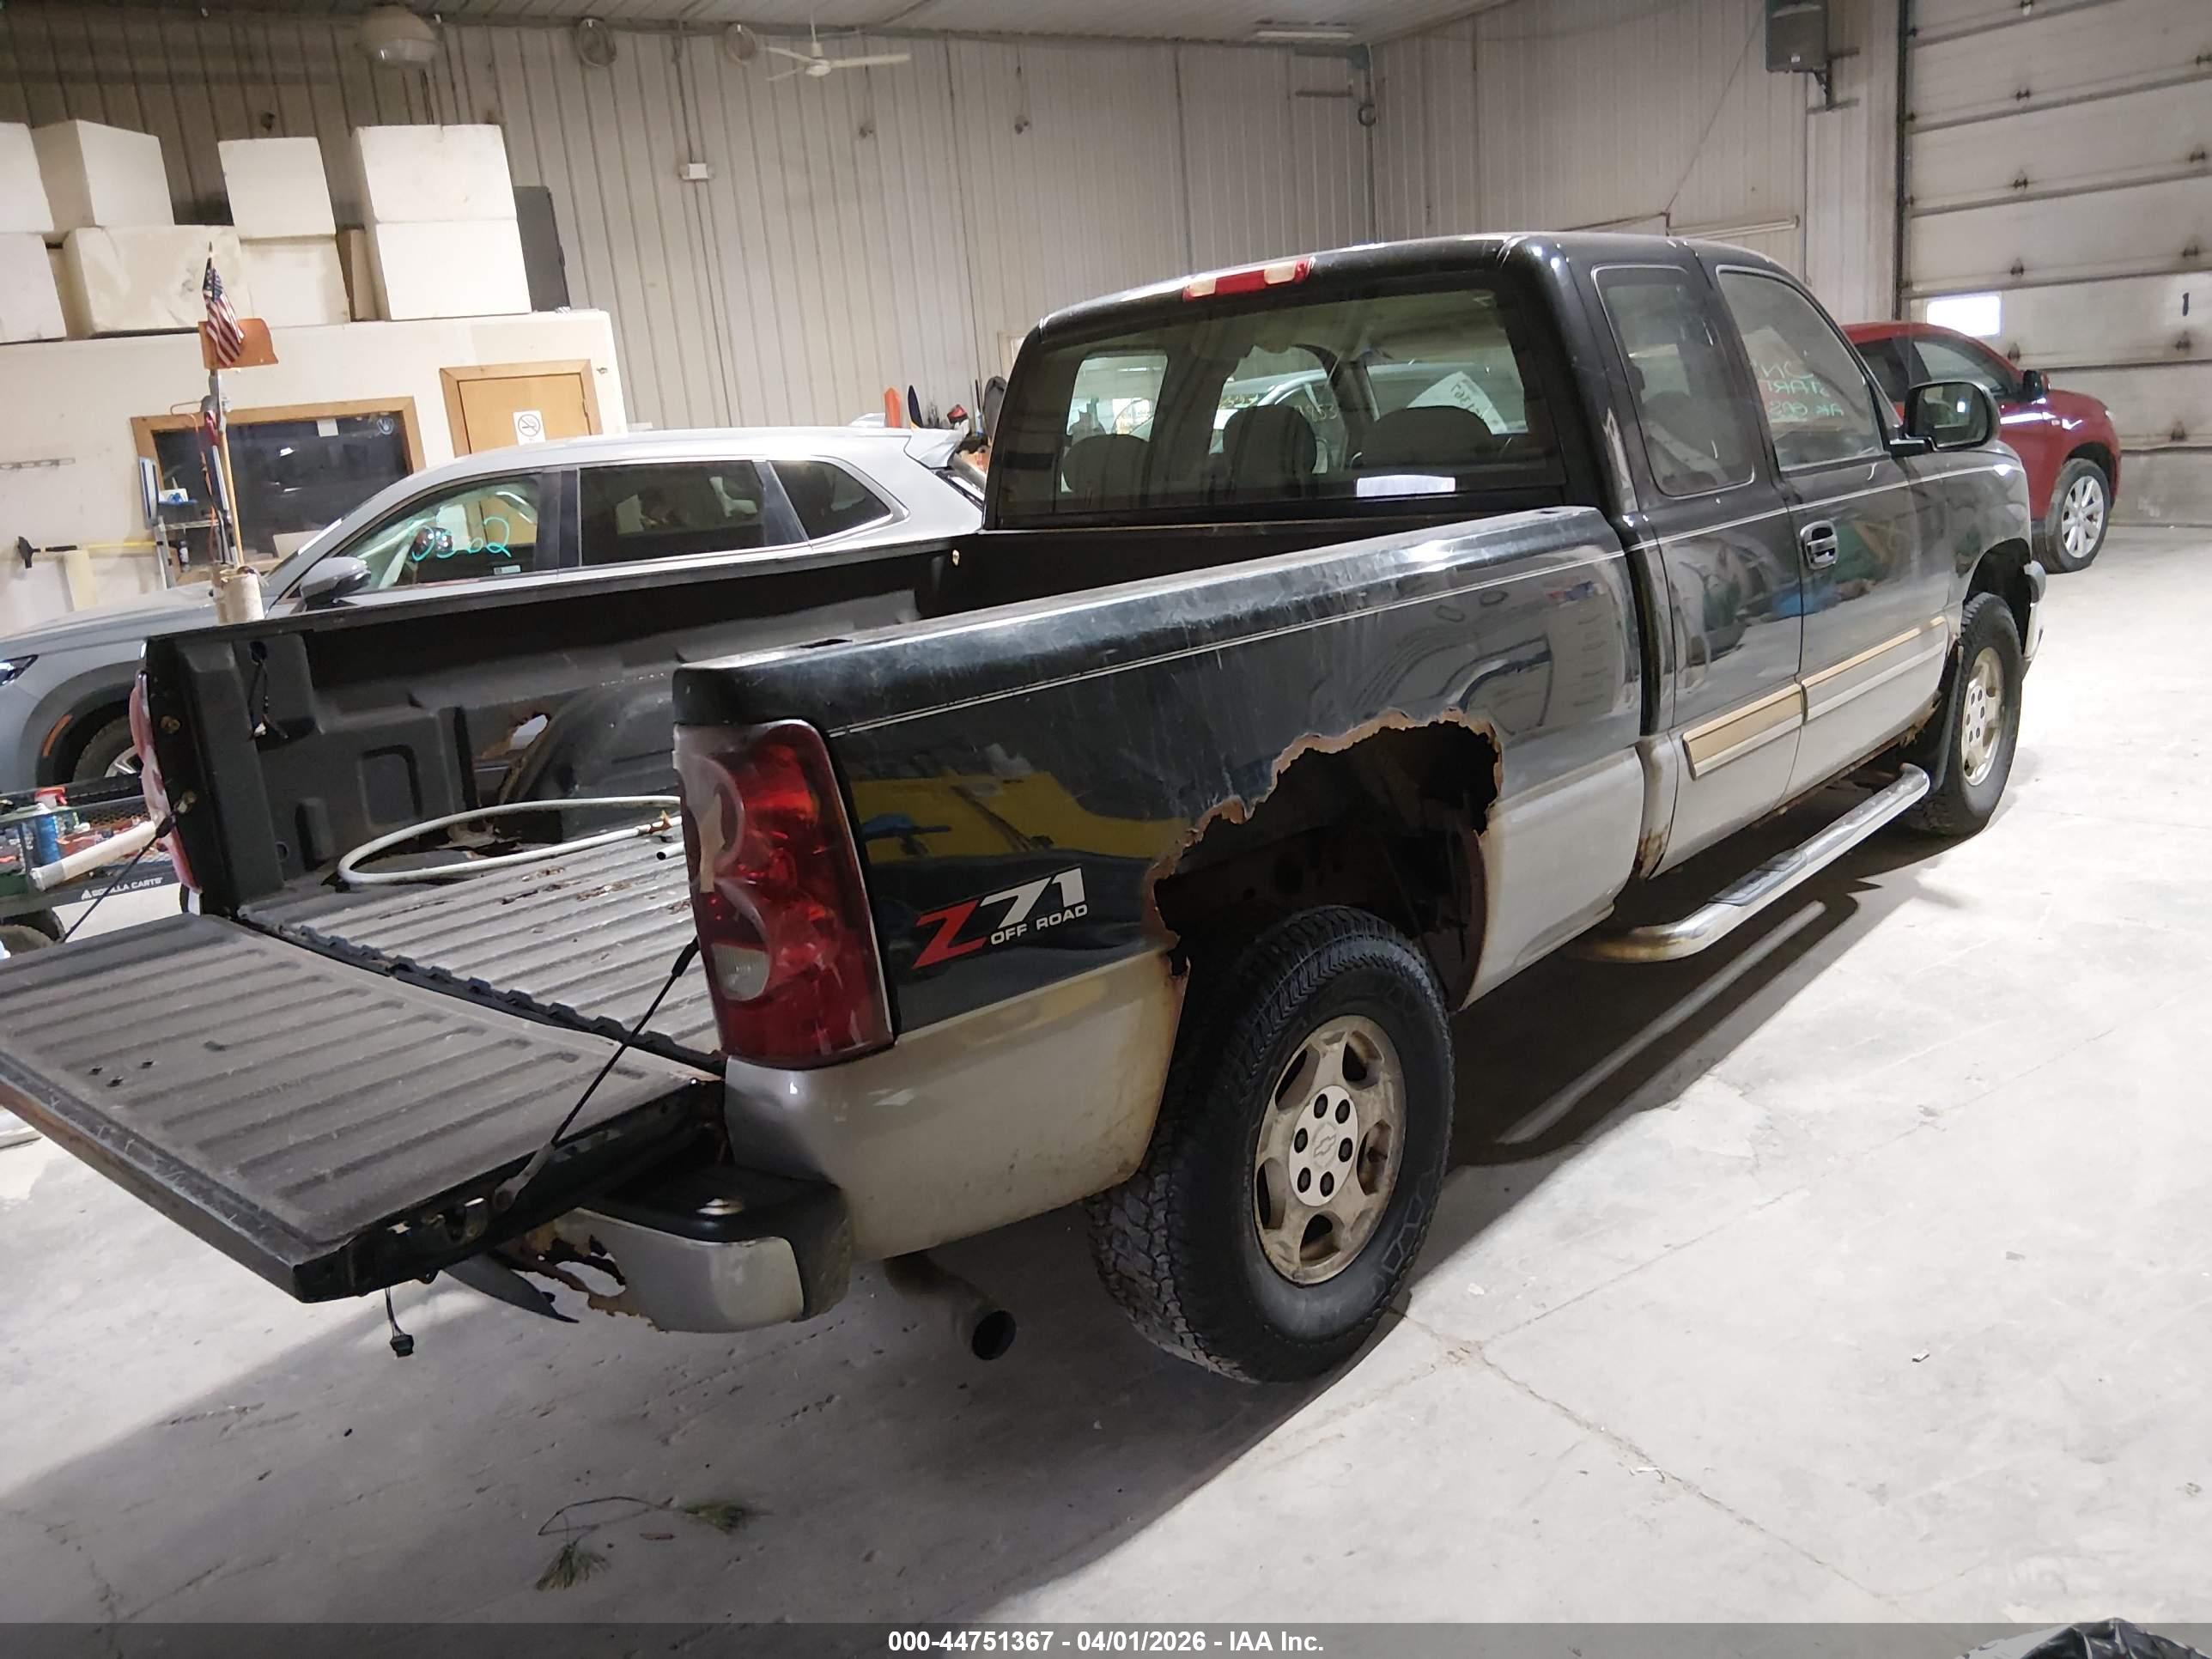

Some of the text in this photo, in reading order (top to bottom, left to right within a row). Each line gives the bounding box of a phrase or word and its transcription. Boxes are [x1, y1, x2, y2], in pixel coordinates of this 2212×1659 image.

[912, 866, 1085, 969] Z71
[990, 903, 1088, 945] OFF ROAD
